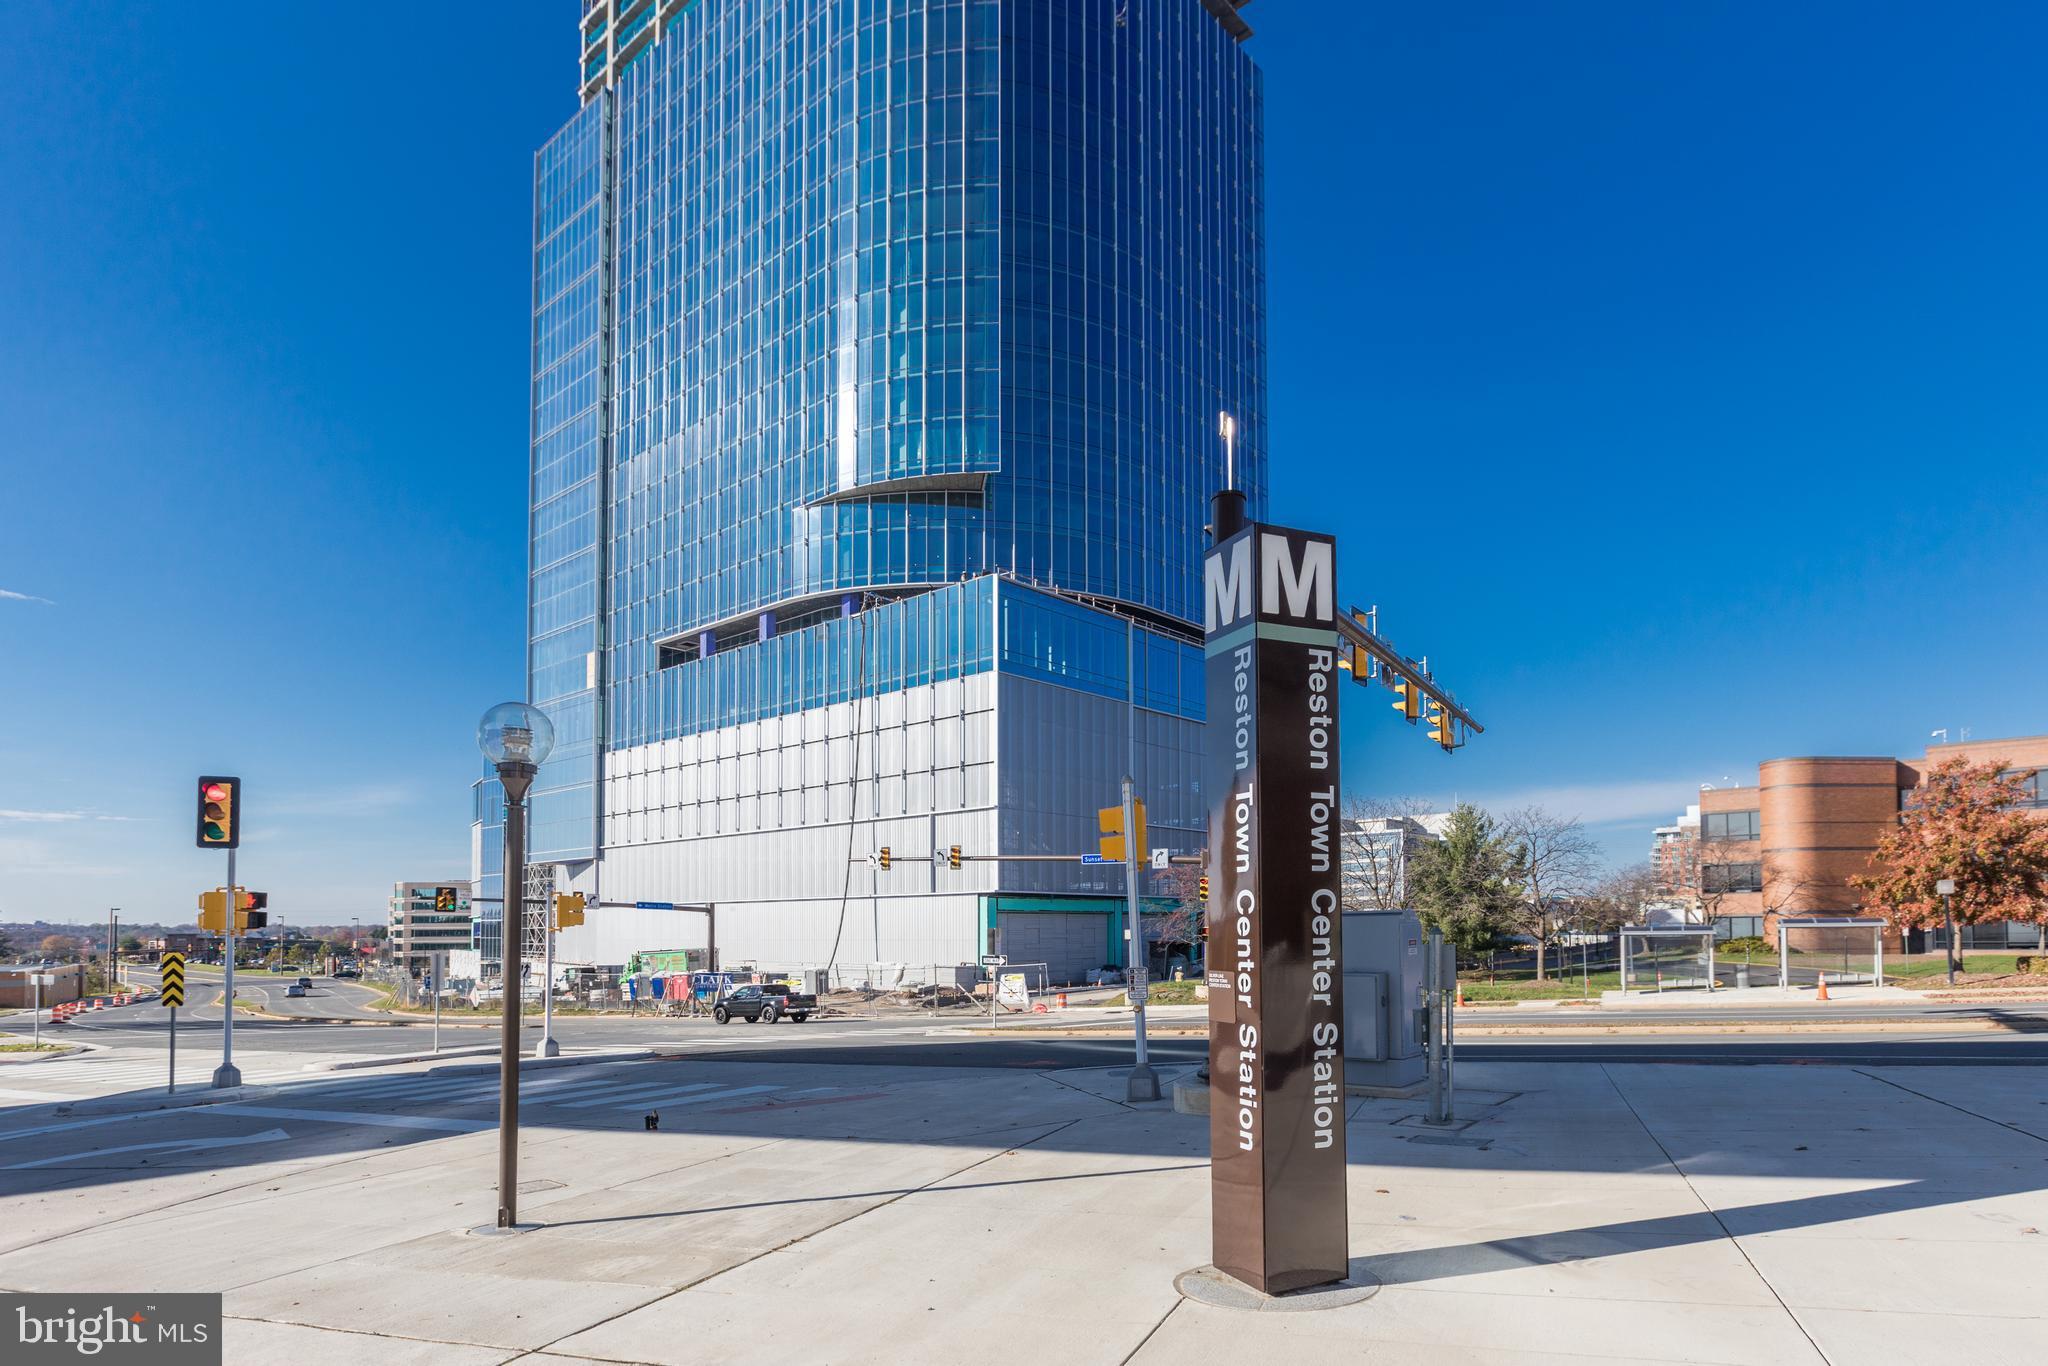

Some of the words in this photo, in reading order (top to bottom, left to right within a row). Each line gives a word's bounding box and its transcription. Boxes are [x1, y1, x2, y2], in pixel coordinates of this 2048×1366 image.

[1205, 535, 1252, 635] M
[1261, 532, 1333, 622] M
[1234, 645, 1252, 770] Reston
[1308, 648, 1333, 770] Reston
[1235, 783, 1254, 873] Town
[1310, 785, 1335, 872] Town
[1236, 888, 1256, 1008] Center
[1311, 888, 1337, 1006] Center
[1238, 1023, 1258, 1151] Station
[1312, 1022, 1339, 1149] Station
